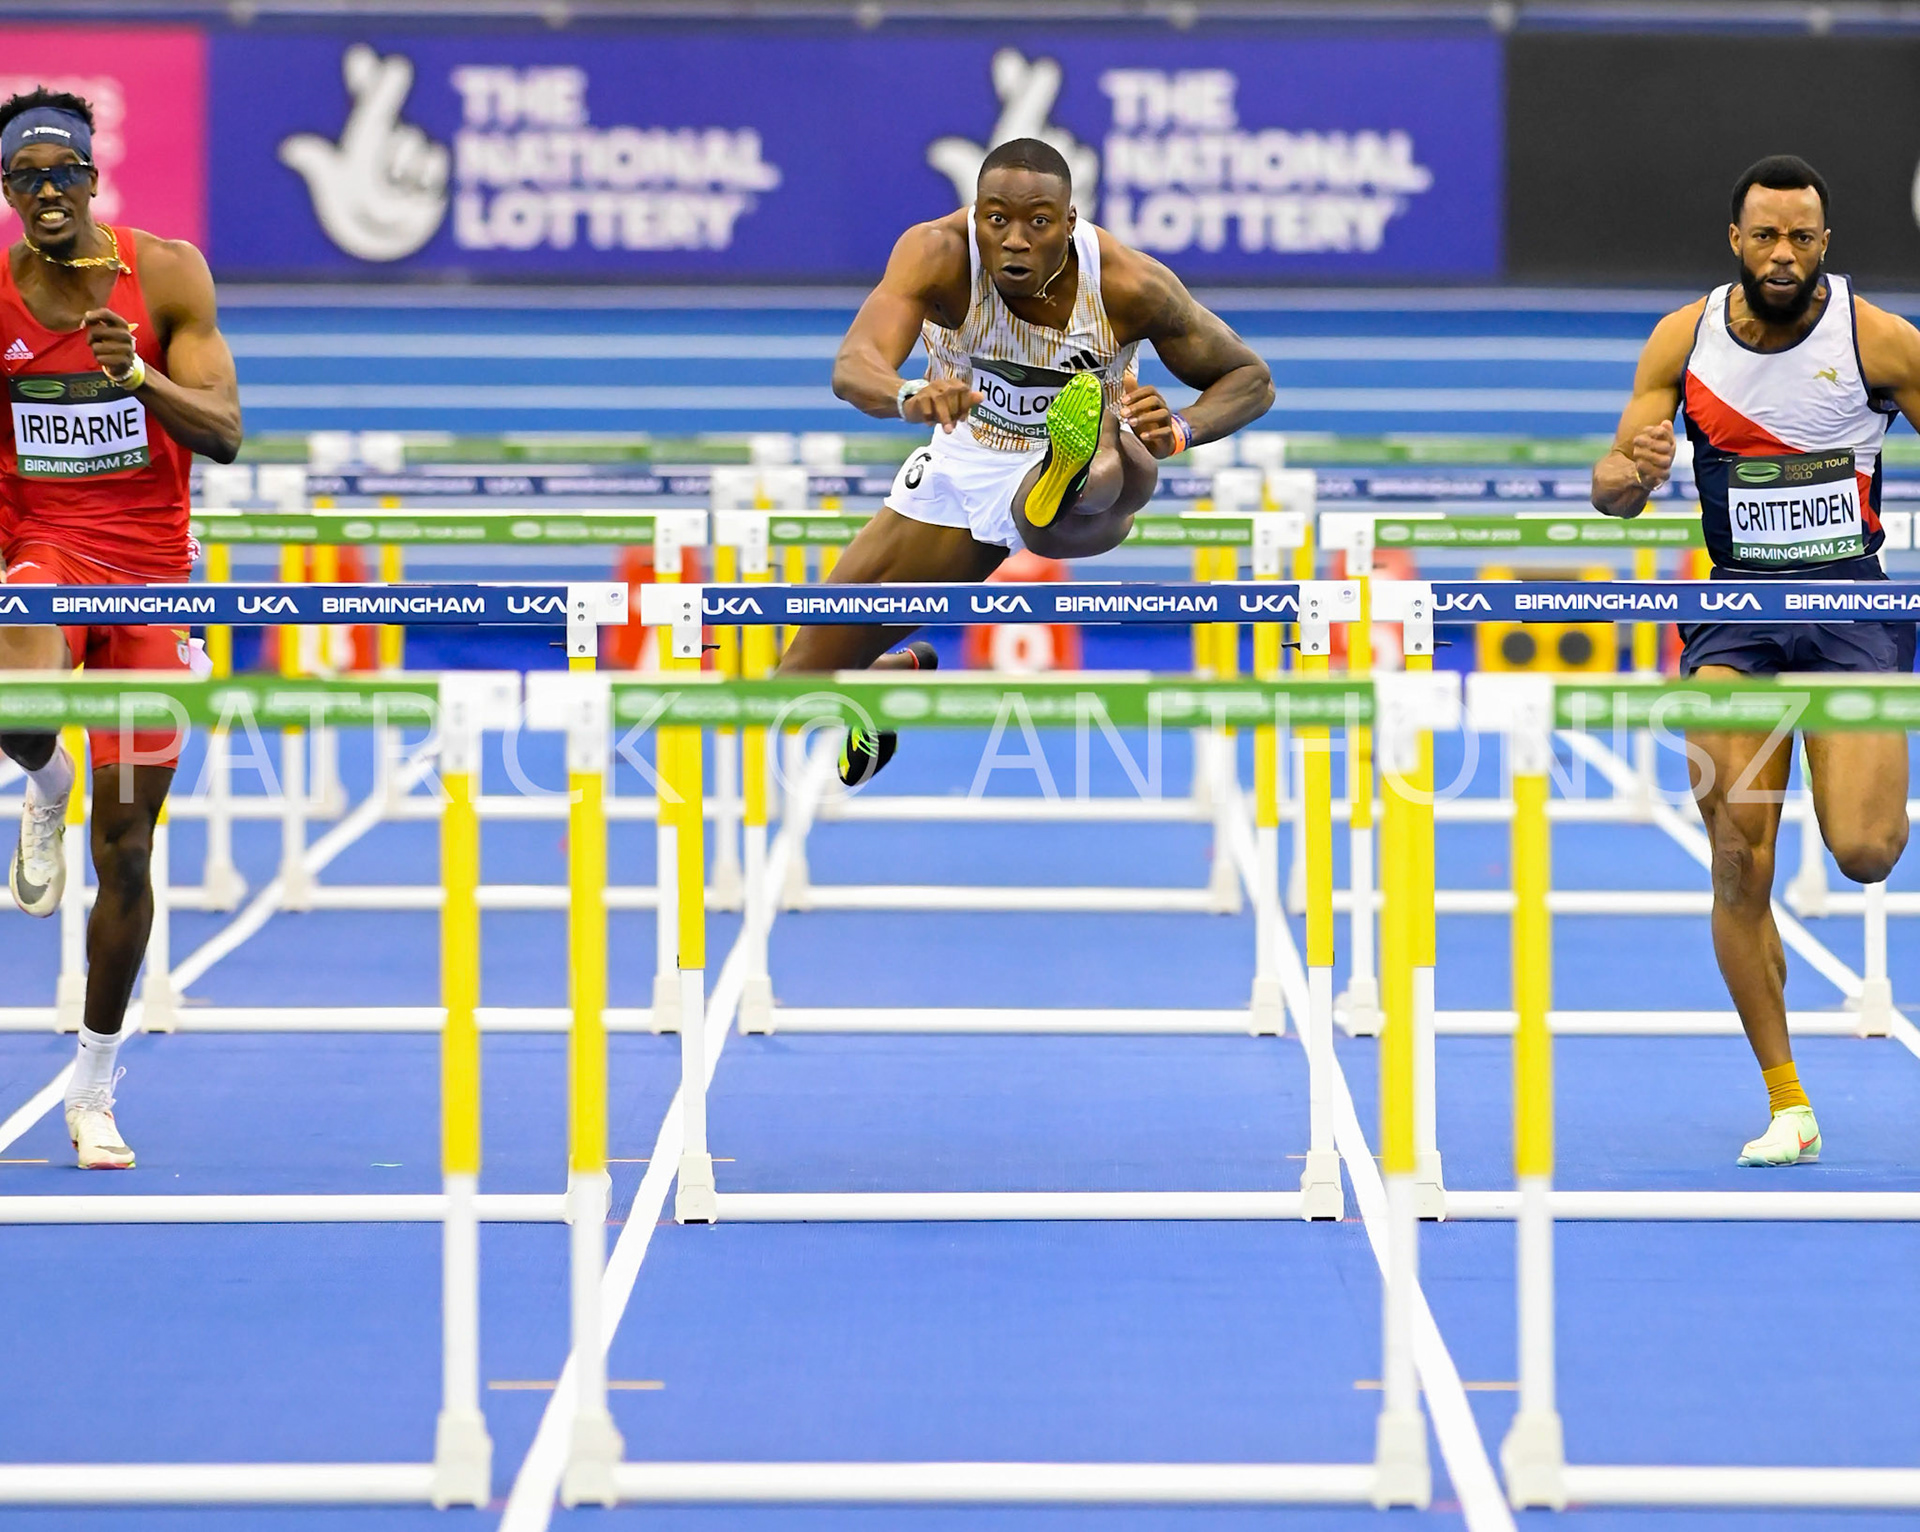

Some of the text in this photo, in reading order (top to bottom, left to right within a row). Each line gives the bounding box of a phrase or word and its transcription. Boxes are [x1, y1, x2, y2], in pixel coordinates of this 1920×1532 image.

[452, 64, 588, 125] THE
[1101, 69, 1237, 128] THE
[455, 127, 781, 190] NATIONAL
[1105, 130, 1434, 193] NATIONAL
[455, 193, 750, 250] LOTTERY
[1106, 196, 1397, 253] LOTTERY
[4, 352, 34, 361] adidas
[979, 376, 1056, 416] HOLLO
[21, 407, 140, 446] IRIBARNE
[977, 406, 1050, 436] BIRMINGH
[24, 451, 143, 473] BIRMINGHAM 23
[904, 452, 932, 489] 6
[1784, 456, 1849, 473] INDOOR TOUR
[1784, 471, 1813, 481] GOLD
[1736, 492, 1855, 531] CRITTENDEN
[1740, 539, 1857, 560] BIRMINGHAM 23
[52, 596, 568, 613] BIRMINGHAM UKA BIRMINGHAM UKA
[702, 595, 1300, 615] UKA BIRMINGHAM UKA BIRMINGHAM UKA
[1432, 593, 1492, 611] UKA
[1515, 593, 1678, 610] BIRMINGHAM
[1700, 593, 1762, 610] UKA
